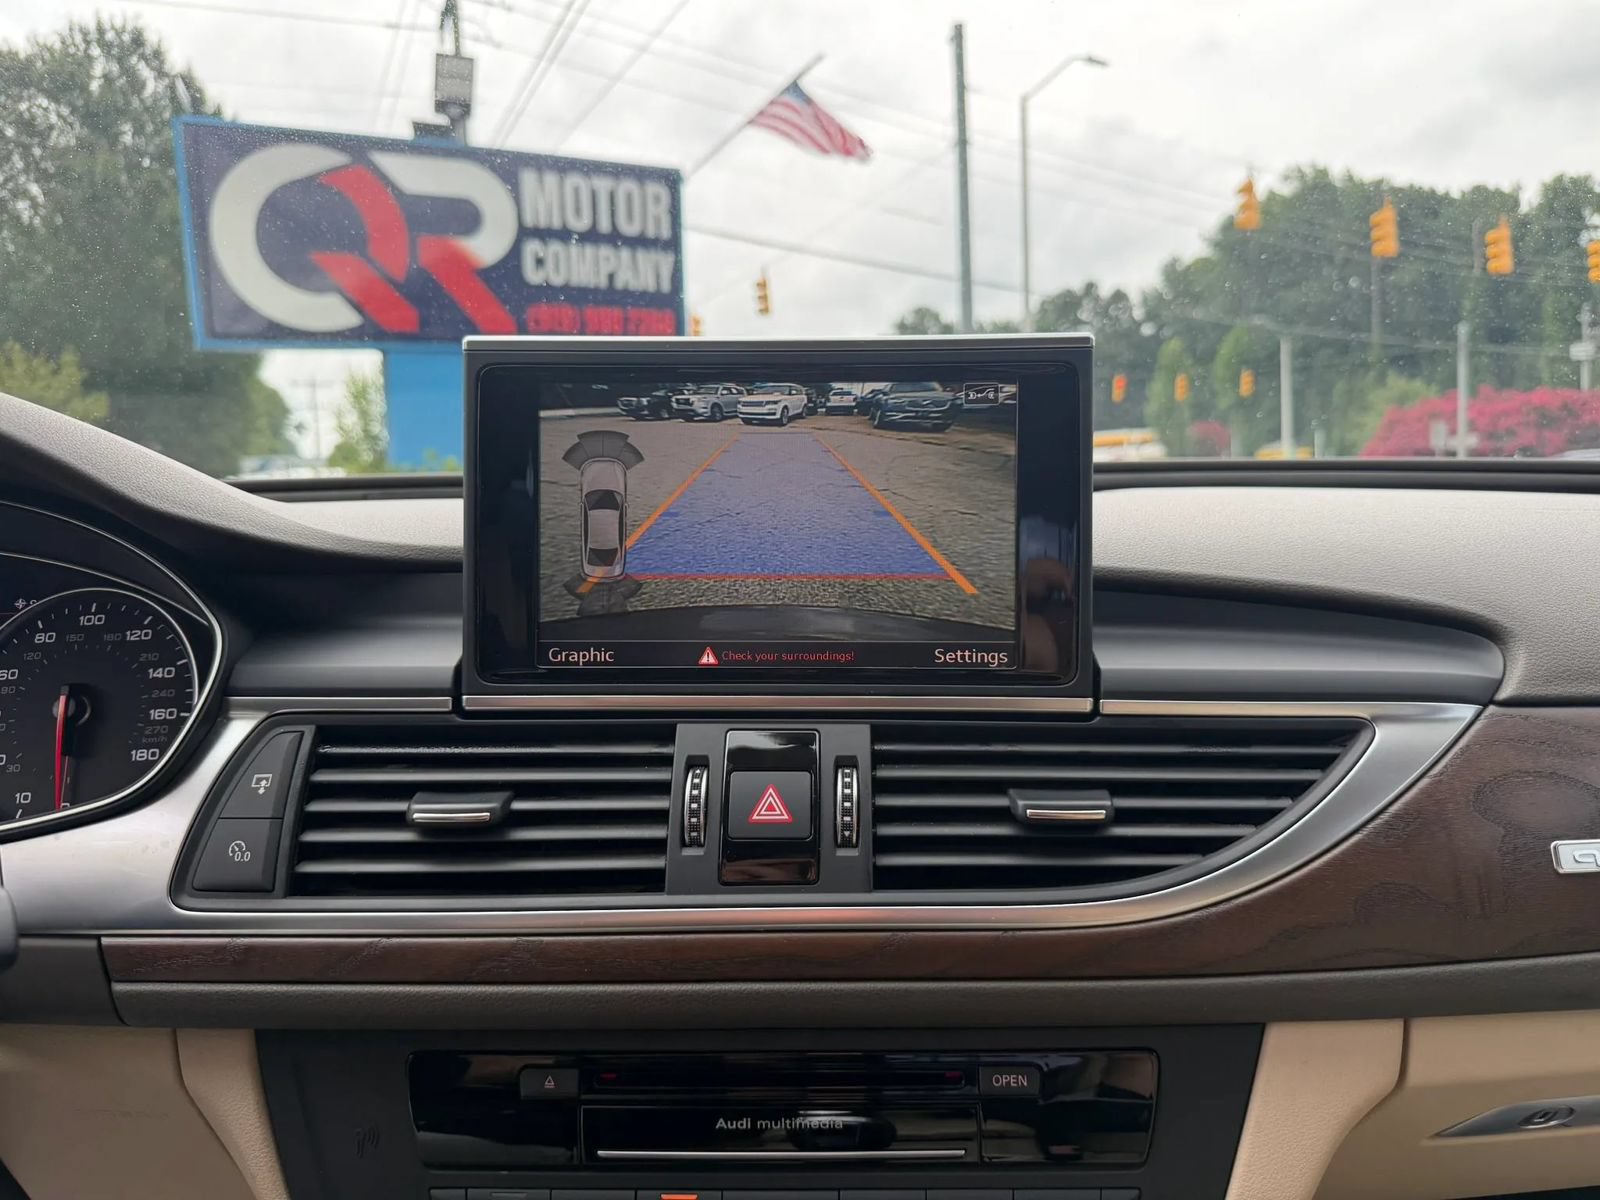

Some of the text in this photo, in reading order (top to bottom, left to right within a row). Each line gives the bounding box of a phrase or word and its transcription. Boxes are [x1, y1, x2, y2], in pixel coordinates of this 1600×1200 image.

[518, 169, 672, 240] MOTOR
[520, 237, 675, 294] COMPANY
[79, 614, 105, 626] 100
[34, 632, 56, 643] 80
[65, 633, 84, 642] 150
[126, 629, 152, 641] 120
[23, 652, 42, 661] 120
[139, 652, 159, 661] 210
[548, 647, 615, 666] Graphic
[721, 650, 855, 663] Check your surroundings!
[934, 647, 1009, 667] Settings
[148, 667, 176, 679] 140
[151, 688, 176, 698] 240
[149, 708, 177, 720] 160
[144, 725, 169, 734] 270
[142, 735, 168, 743] km/h
[130, 748, 160, 761] 180
[6, 763, 21, 773] 30
[15, 792, 32, 804] 10
[234, 851, 251, 862] 0.0
[992, 1074, 1028, 1087] OPEN
[715, 1117, 844, 1129] Audi multimedia
